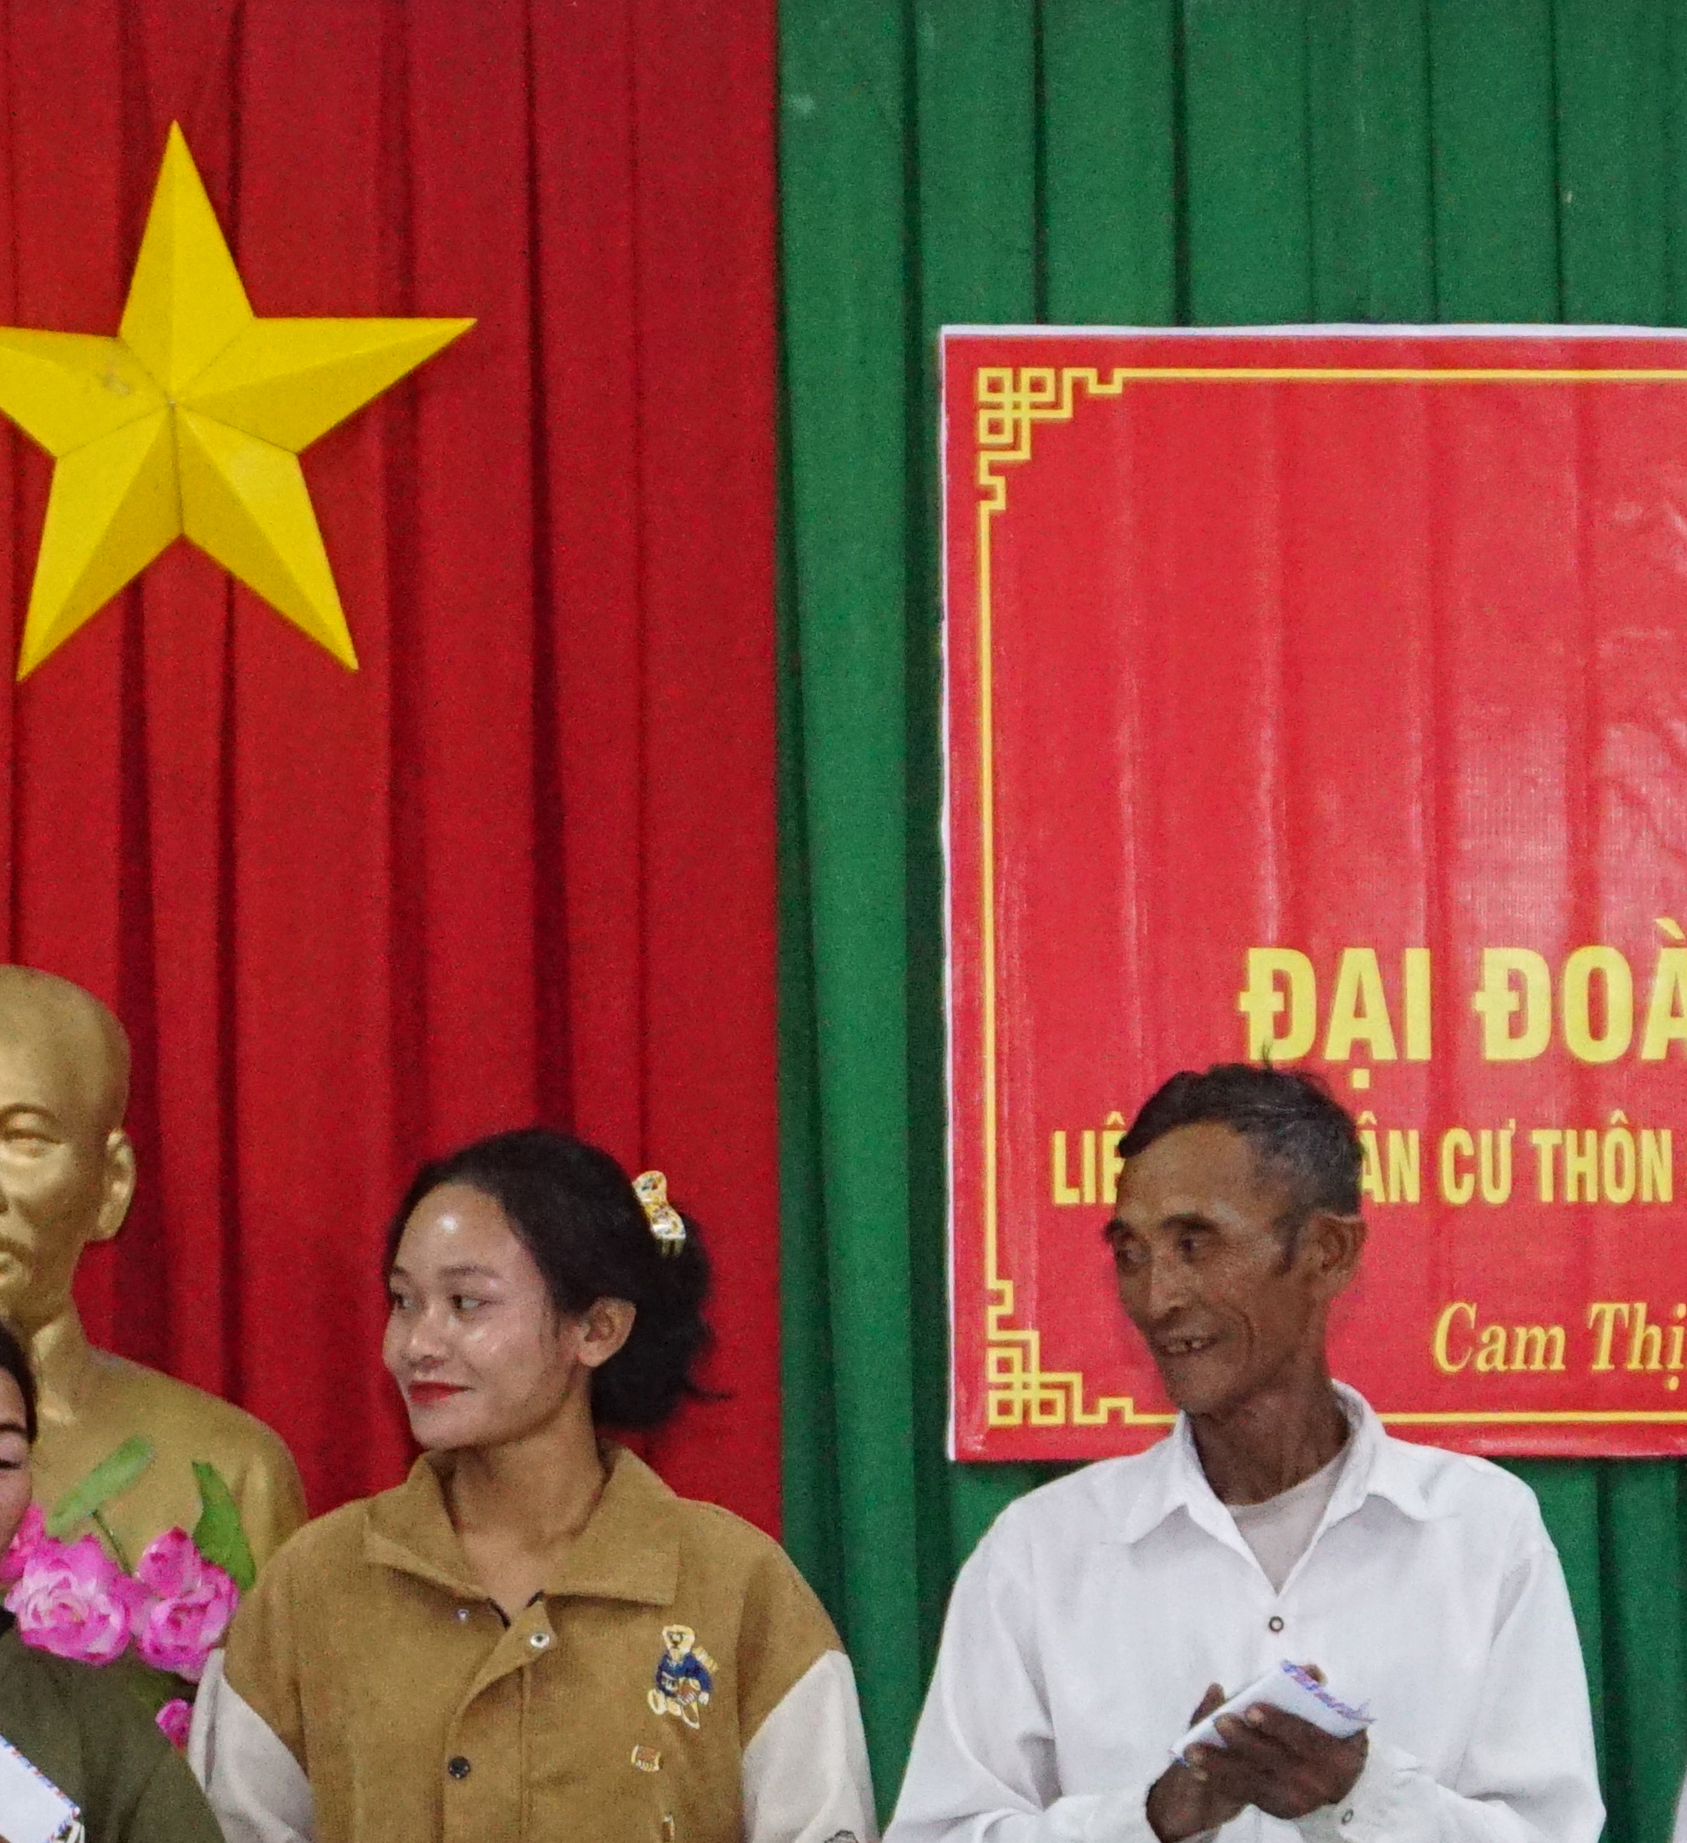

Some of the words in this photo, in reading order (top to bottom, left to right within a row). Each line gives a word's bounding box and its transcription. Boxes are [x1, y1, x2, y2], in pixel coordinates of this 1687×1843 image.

[1237, 945, 1432, 1090] ĐẠI
[1050, 1110, 1127, 1206] LIÊ
[1357, 1110, 1422, 1205] ÂN
[1439, 1119, 1517, 1206] CƯ
[1527, 1110, 1674, 1205] THÔN
[1433, 1301, 1567, 1374] Cam
